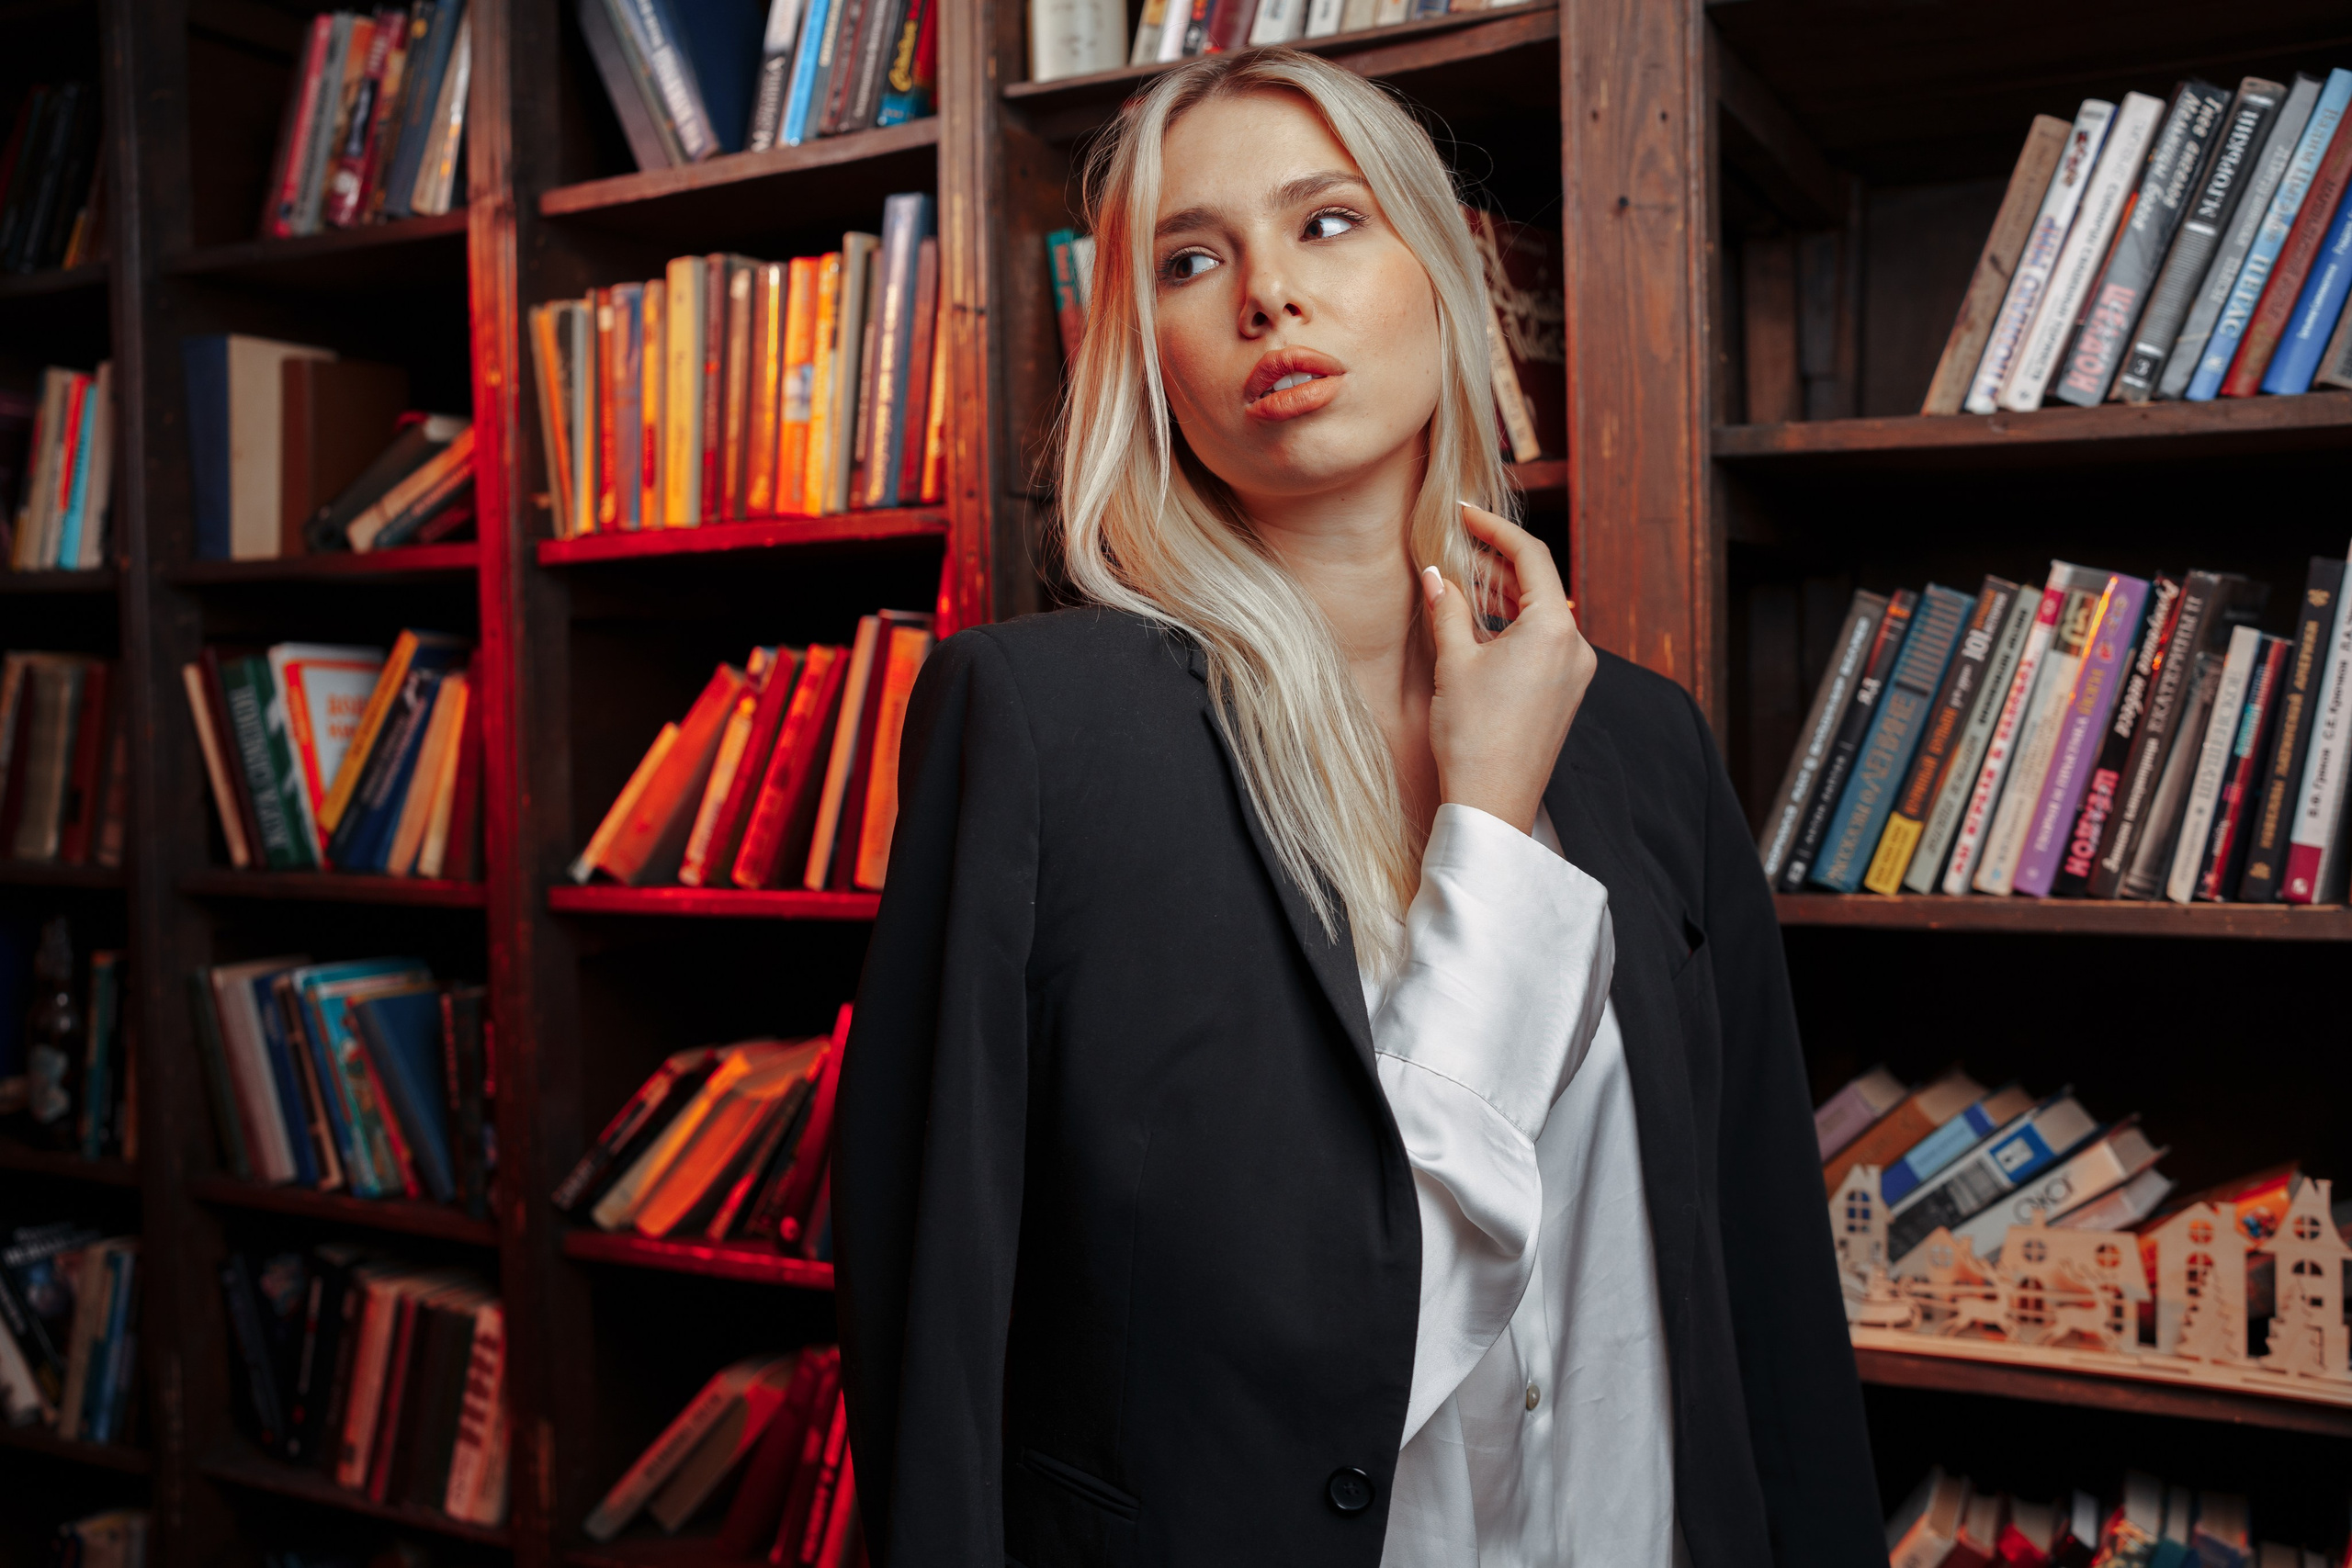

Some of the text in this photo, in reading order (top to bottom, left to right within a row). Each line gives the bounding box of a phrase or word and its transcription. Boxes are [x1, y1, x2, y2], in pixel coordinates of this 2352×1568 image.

[2130, 90, 2202, 233] Мельницы богов
[2161, 95, 2224, 209] Гнев ангелов
[2195, 106, 2260, 220] М.ГОРЬКИЙ
[2299, 104, 2340, 165] Вадим
[1983, 271, 2041, 379] ПОЗНАЮ
[2023, 212, 2063, 270] МИР
[2064, 279, 2136, 395] ШЕЛДОН
[2218, 251, 2271, 341] ПЕГАС
[1960, 627, 1993, 662] 101
[2112, 577, 2181, 739] Рухнувшие небеса
[2144, 612, 2199, 735] ЕКАТЕРИНЫ
[2290, 618, 2321, 691] АМЕРИКИ
[1855, 691, 1918, 794] ЛЕНИНЕ
[1926, 705, 1959, 756] БУЛЬОН
[2054, 713, 2091, 788] ПРАКТИКА
[2312, 747, 2333, 789] Греков
[2327, 659, 2349, 714] Крючков
[2063, 765, 2120, 878] ШЕЛДОН
